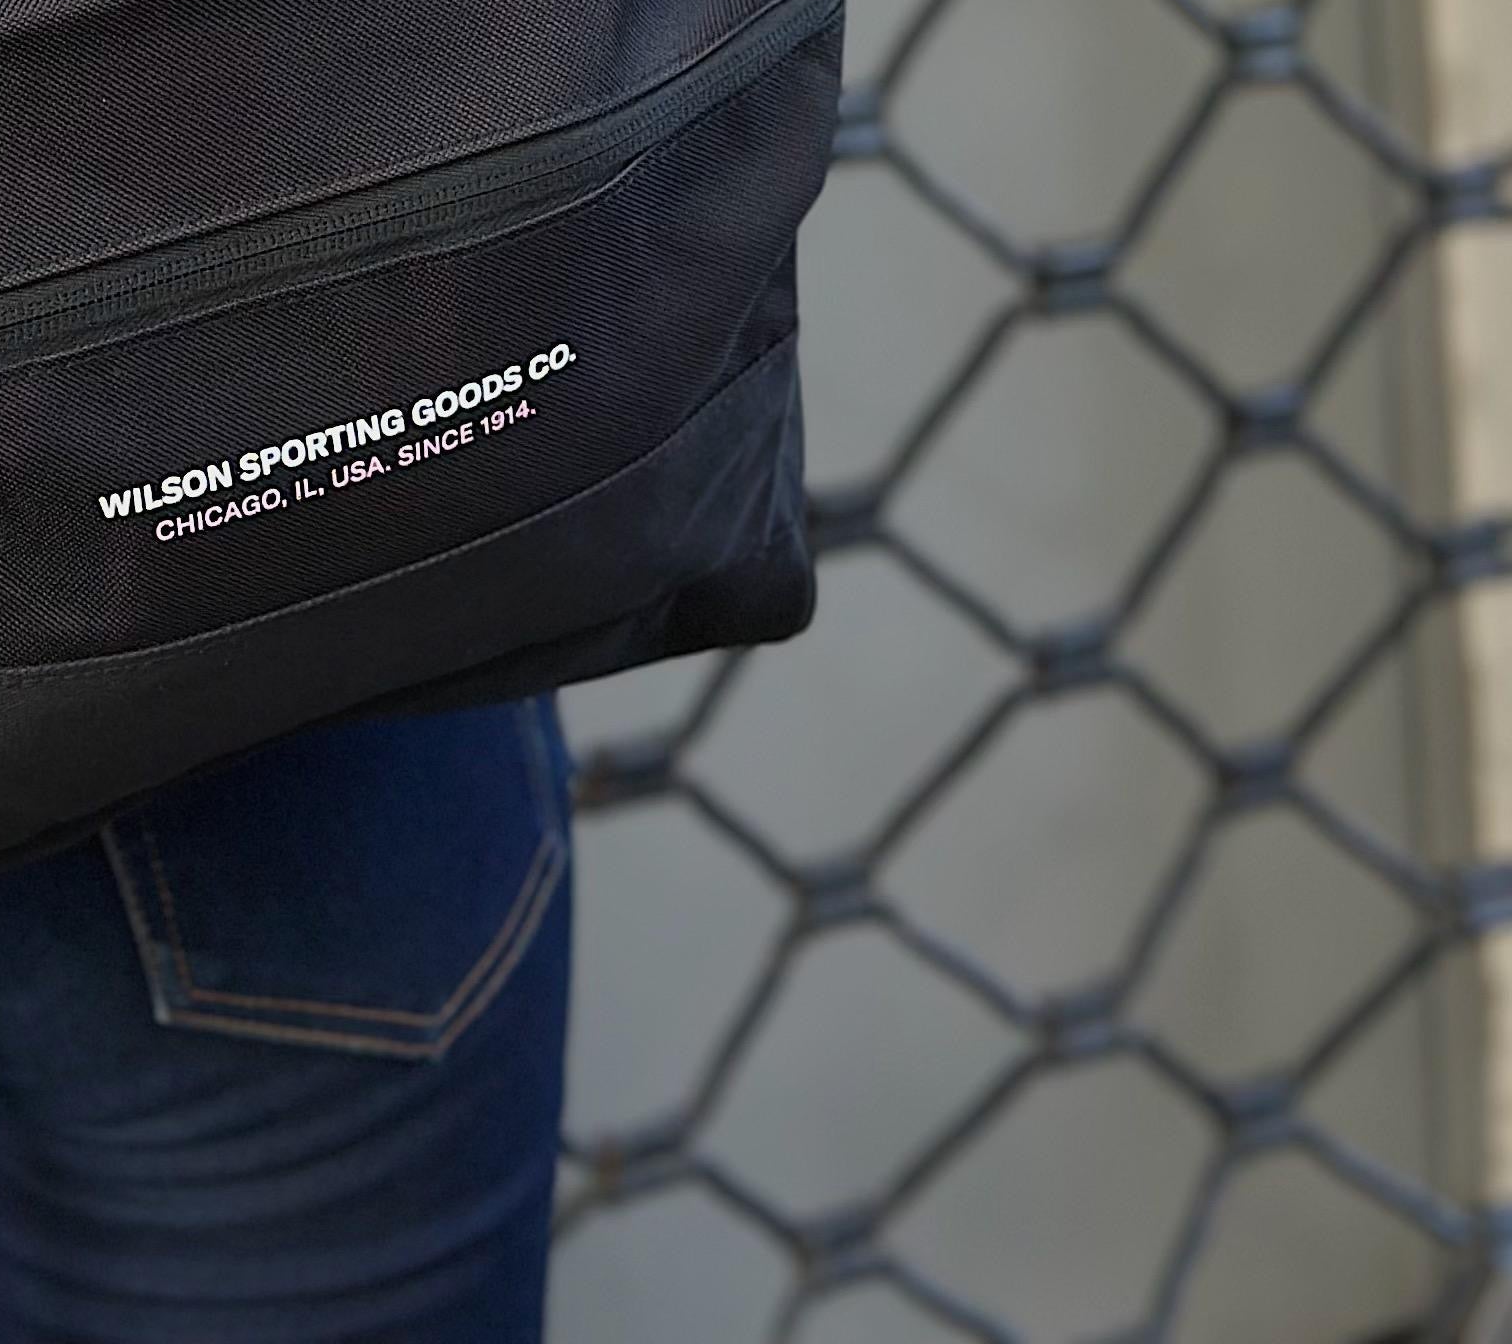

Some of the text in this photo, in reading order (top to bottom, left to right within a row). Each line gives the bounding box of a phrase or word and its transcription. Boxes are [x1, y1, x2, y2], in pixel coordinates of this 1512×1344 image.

[98, 343, 577, 519] WILSON SPORTING GOODS CO.
[155, 488, 288, 541] CHICAGO,
[331, 456, 392, 488] USA.
[397, 421, 474, 467] SINCE
[479, 399, 537, 435] 1914.
